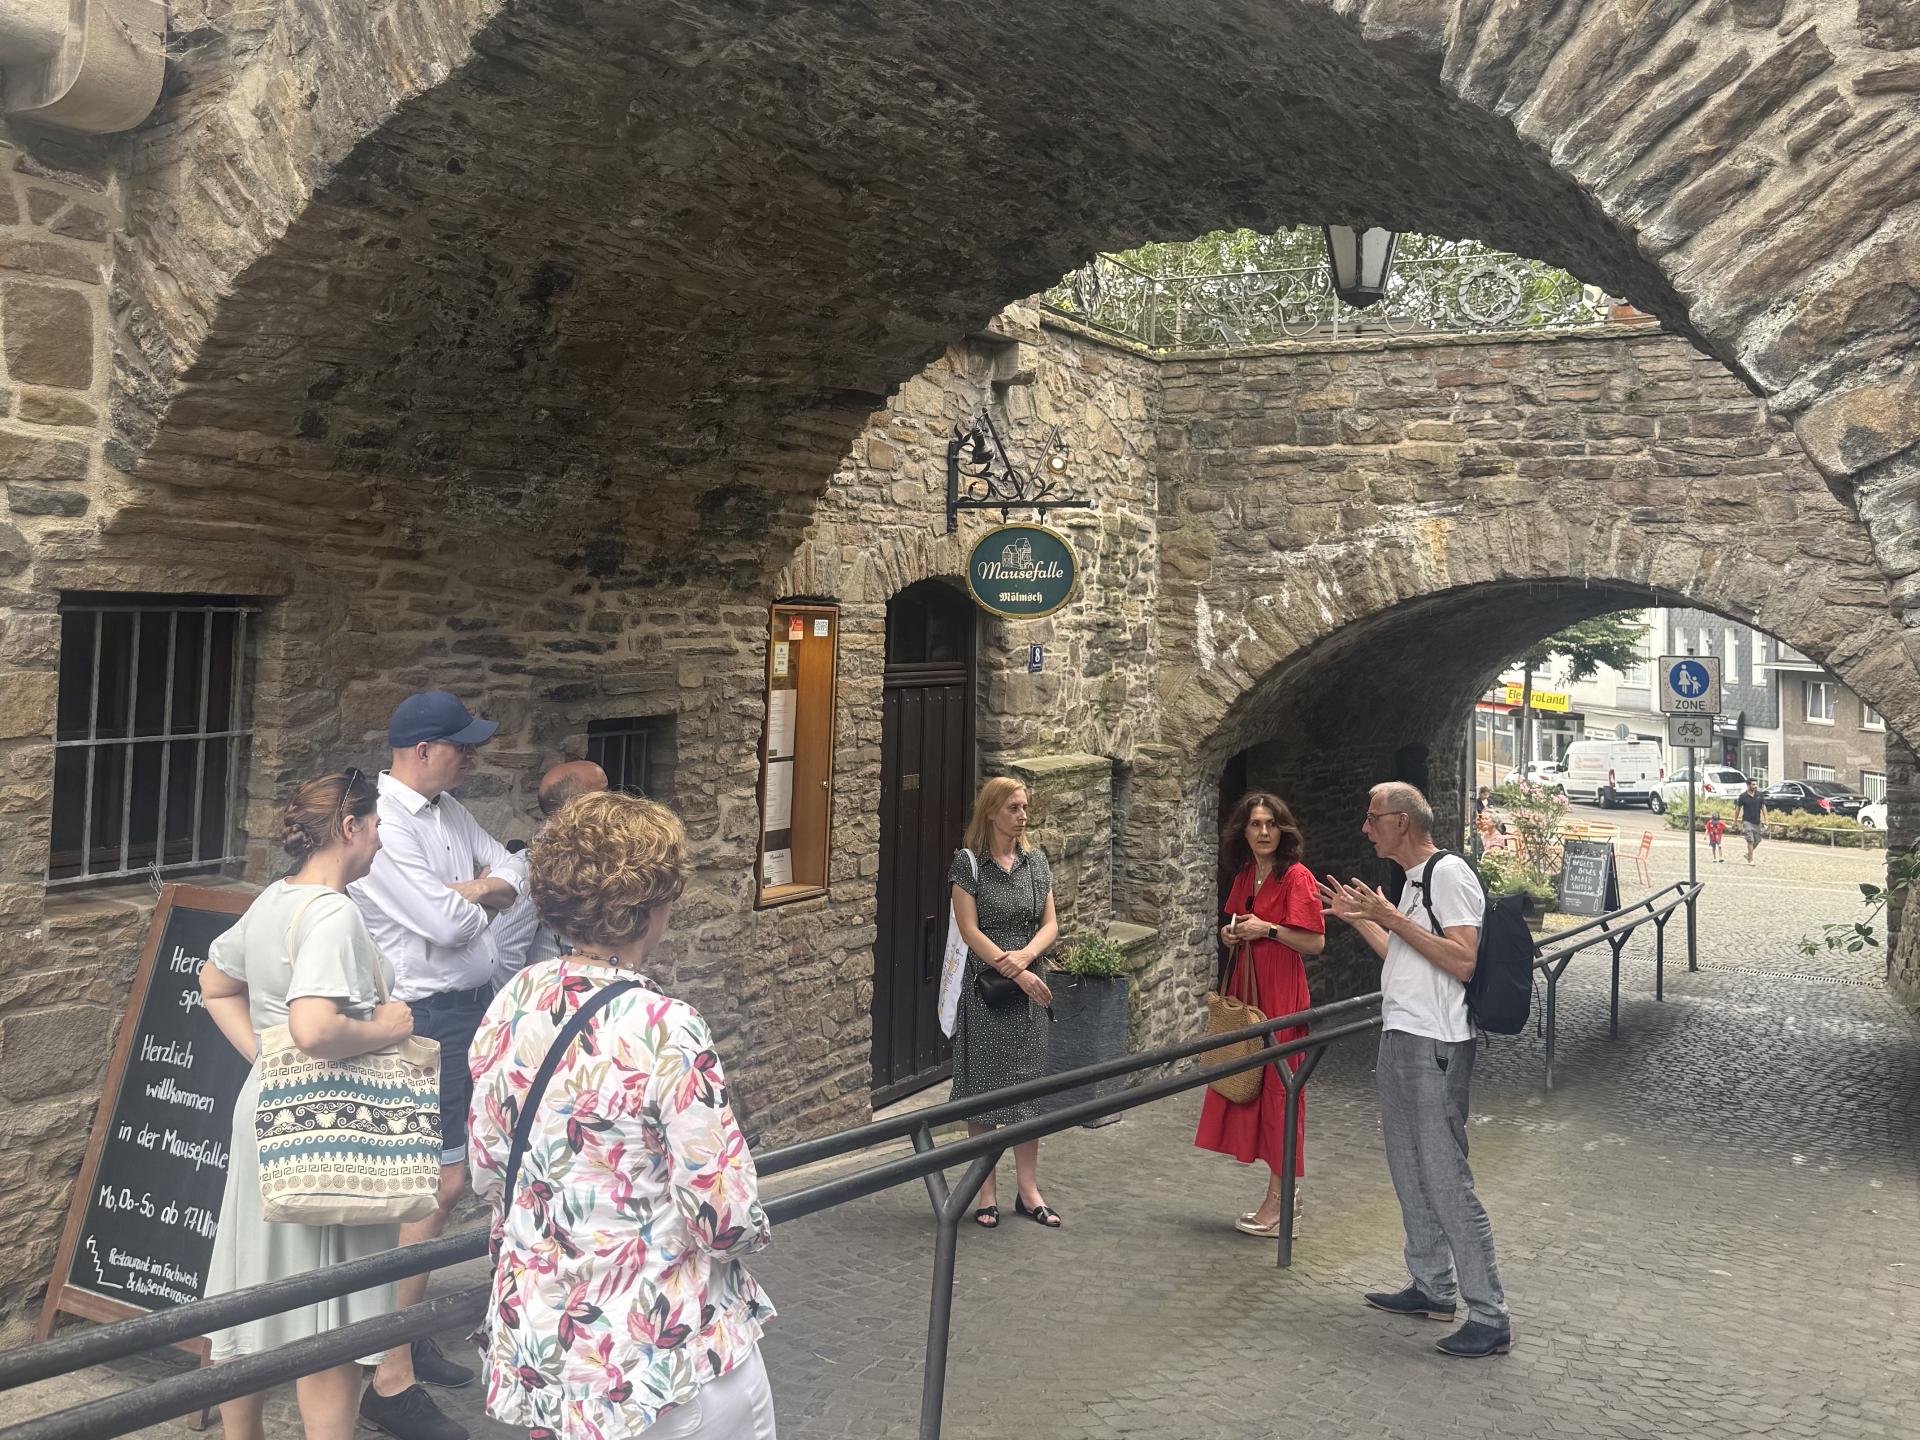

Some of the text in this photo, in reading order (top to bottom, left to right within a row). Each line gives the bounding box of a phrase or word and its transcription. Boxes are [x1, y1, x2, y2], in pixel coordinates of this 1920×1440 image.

[977, 560, 1064, 582] Mausefalle
[1034, 647, 1041, 663] 8
[1508, 689, 1566, 706] EleroLand
[1675, 699, 1706, 711] ZONE
[170, 945, 206, 976] Here
[179, 989, 206, 1014] spa
[140, 1034, 194, 1069] Herzlich
[145, 1077, 215, 1114] willkommen
[118, 1120, 229, 1172] in der Mausefalle
[160, 1200, 178, 1225] ab
[108, 1247, 198, 1290] Restaurant im Fachwerk
